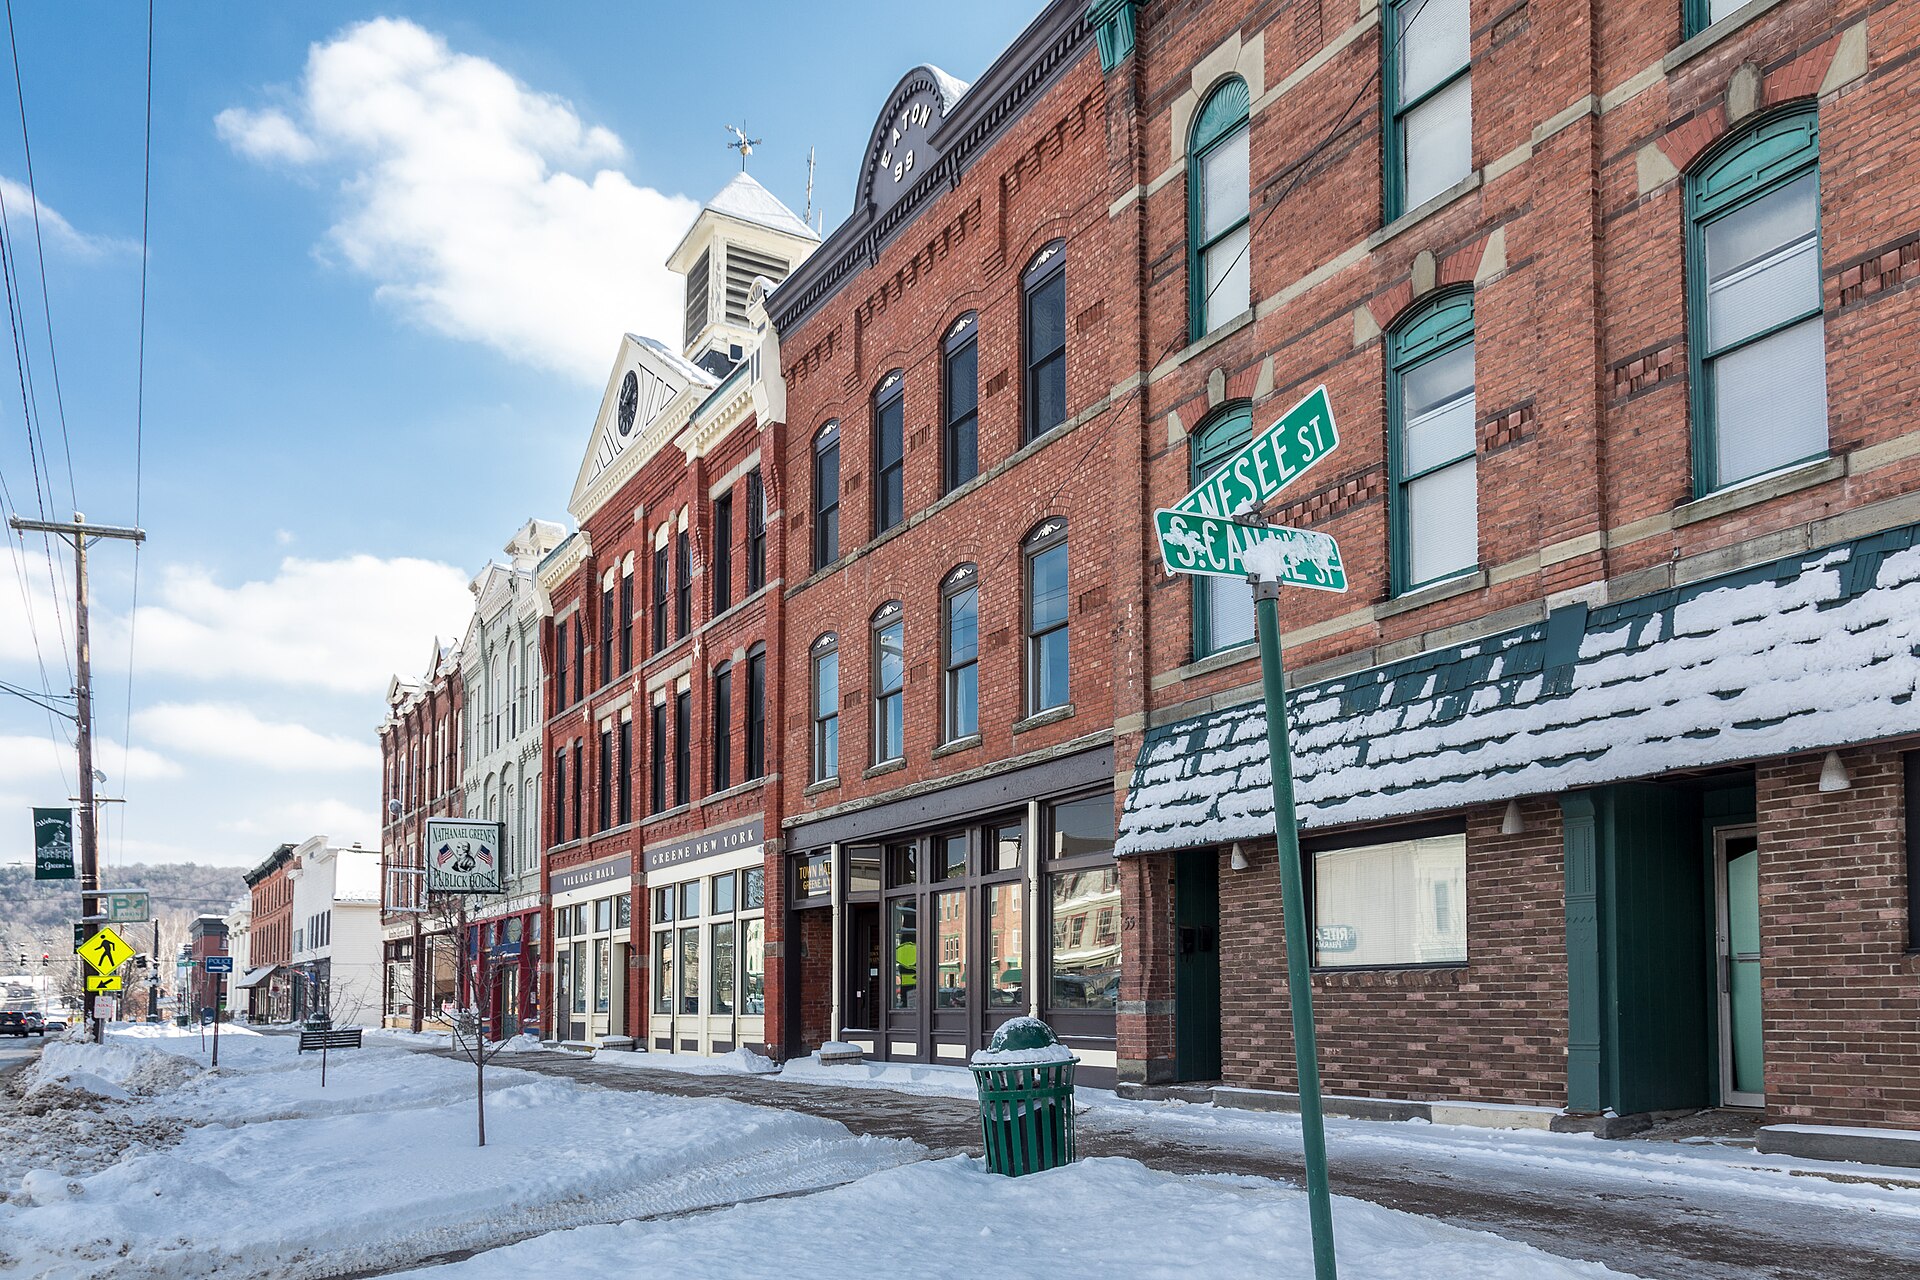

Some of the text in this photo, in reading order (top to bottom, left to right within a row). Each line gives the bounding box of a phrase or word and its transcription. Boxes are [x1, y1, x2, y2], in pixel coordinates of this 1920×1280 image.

[881, 103, 931, 169] EATON
[1181, 414, 1326, 518] NESEE ST
[36, 817, 65, 827] Welcome
[433, 828, 496, 845] NATHANAEL GREENE'S
[652, 829, 754, 865] GREENE NEW YORK
[433, 869, 496, 888] PUBLICK HOUSE
[563, 866, 615, 887] VILLAGE HALL
[799, 864, 817, 879] TOWN
